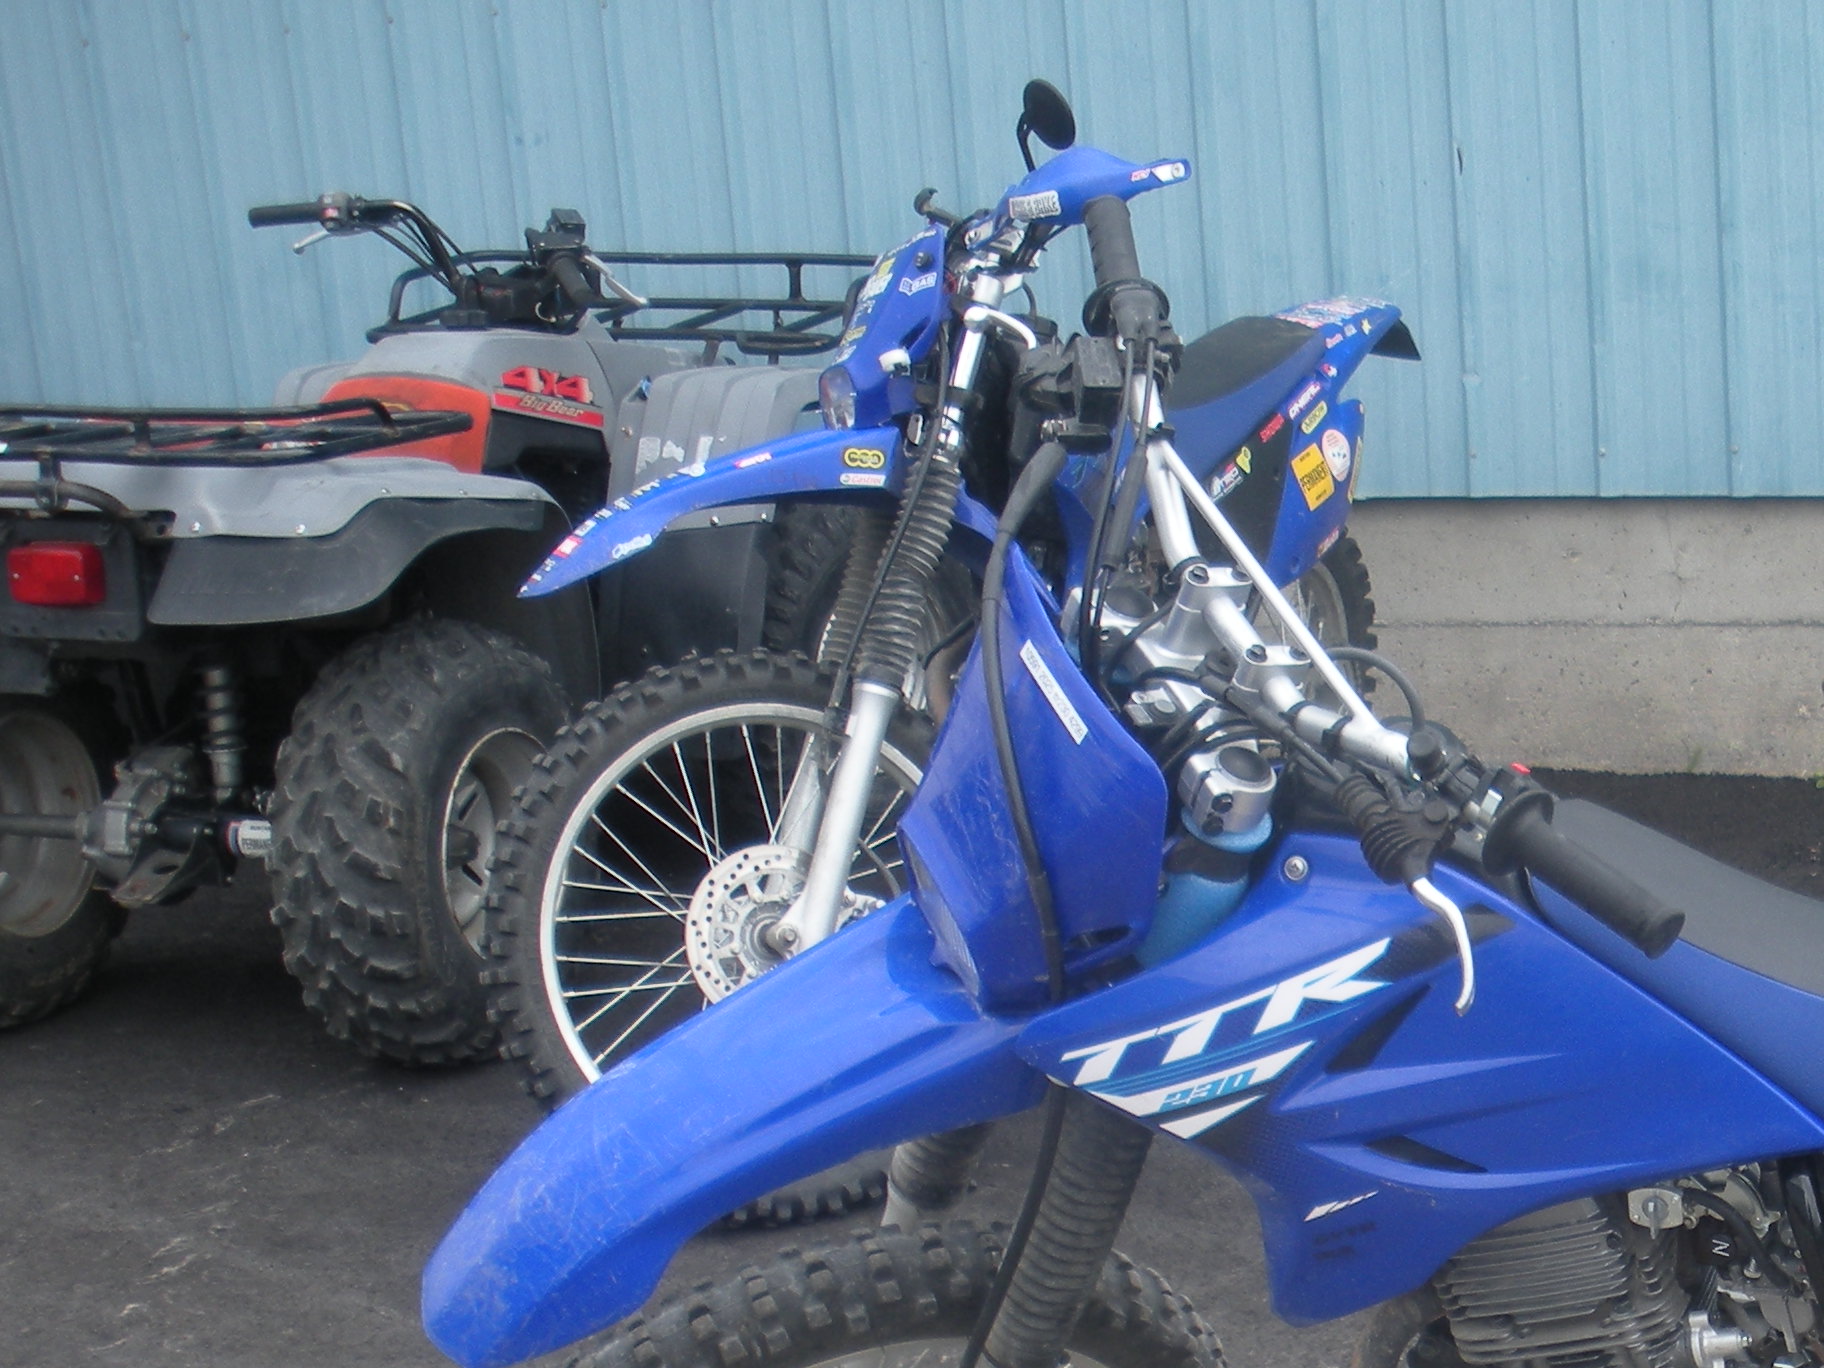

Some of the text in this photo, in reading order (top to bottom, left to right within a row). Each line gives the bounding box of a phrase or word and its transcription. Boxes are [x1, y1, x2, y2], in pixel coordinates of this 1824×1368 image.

[519, 394, 584, 417] Big Bear
[1061, 936, 1393, 1086] TTR
